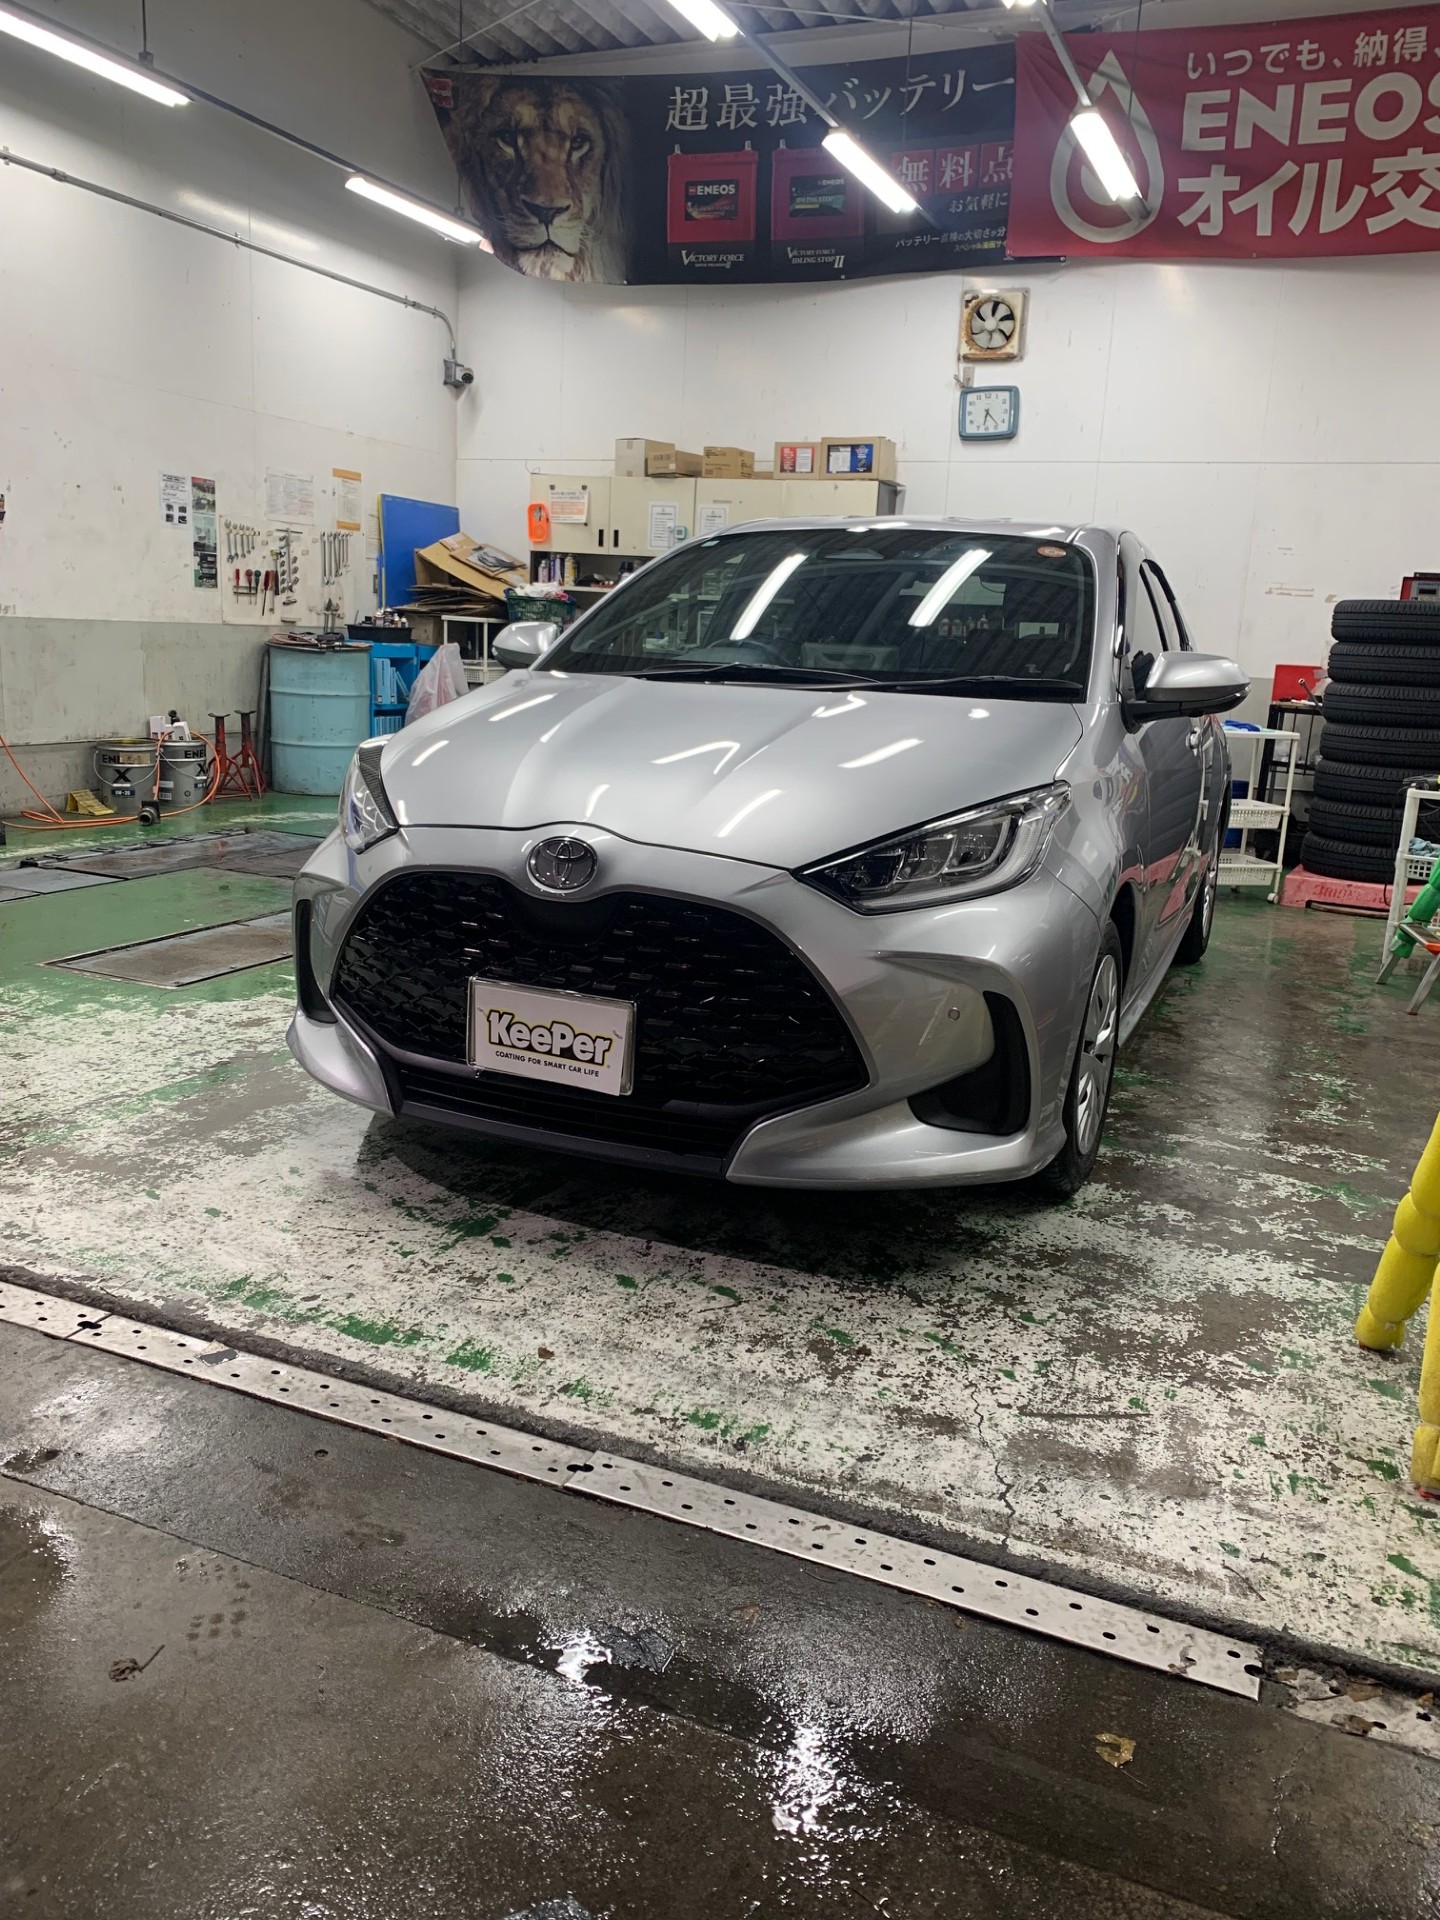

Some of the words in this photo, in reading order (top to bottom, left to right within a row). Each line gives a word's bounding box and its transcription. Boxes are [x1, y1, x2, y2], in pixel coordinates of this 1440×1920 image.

[697, 184, 736, 195] ENEOS
[1177, 147, 1440, 237] オイル交
[948, 192, 1008, 213] お気軽に
[681, 250, 718, 266] VICTORY
[719, 254, 744, 262] FORCE
[112, 767, 132, 783] X
[487, 1009, 612, 1066] KeePer
[495, 1050, 526, 1062] COATING
[527, 1056, 542, 1065] FOR
[543, 1060, 567, 1071] SMART
[568, 1065, 582, 1074] CAR
[583, 1069, 600, 1078] LIFE
